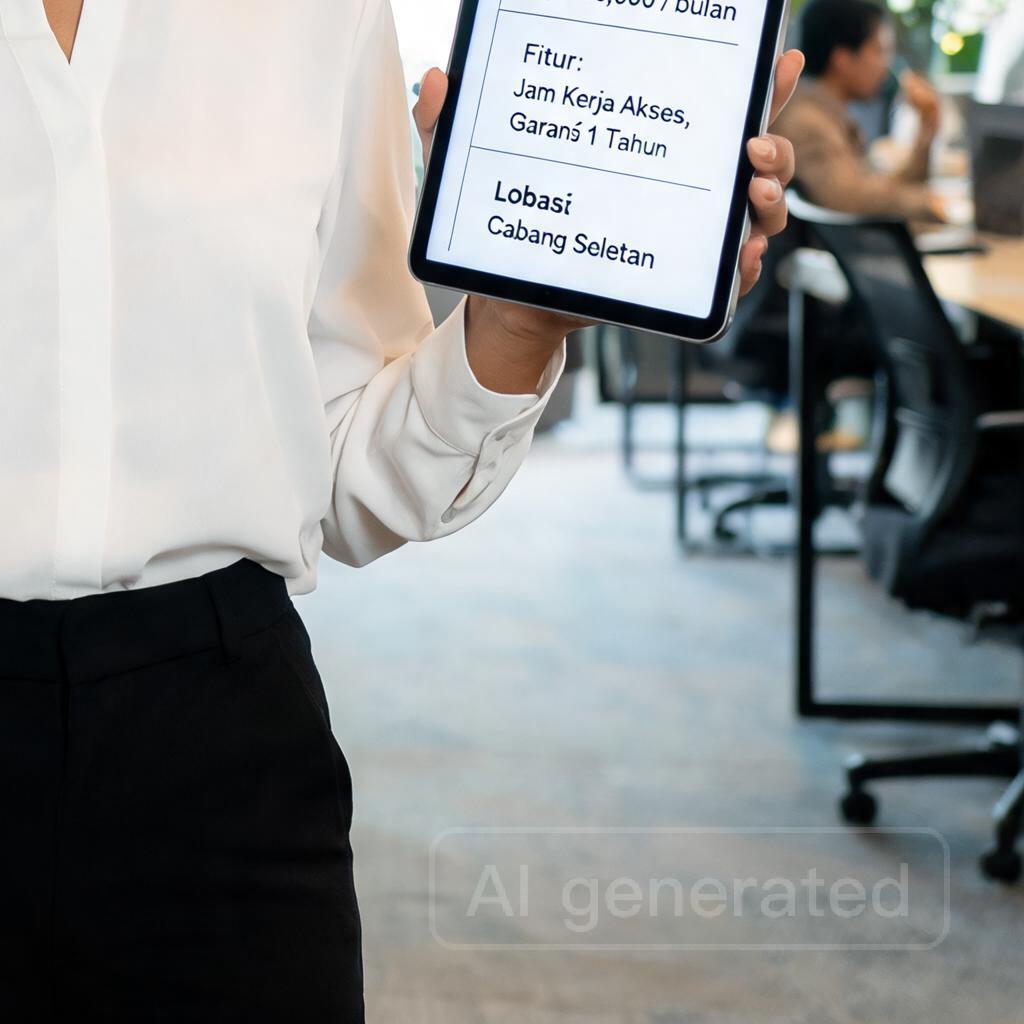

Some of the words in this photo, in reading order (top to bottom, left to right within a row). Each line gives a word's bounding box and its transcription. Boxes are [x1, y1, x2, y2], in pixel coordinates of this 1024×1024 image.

[523, 42, 583, 72] Fitur:
[513, 78, 556, 103] Jam
[561, 85, 615, 116] Kerja
[619, 95, 690, 130] Akses,
[588, 125, 597, 146] 1
[606, 127, 667, 158] Tahun
[487, 215, 568, 255] Cabang
[572, 232, 655, 270] Seletan
